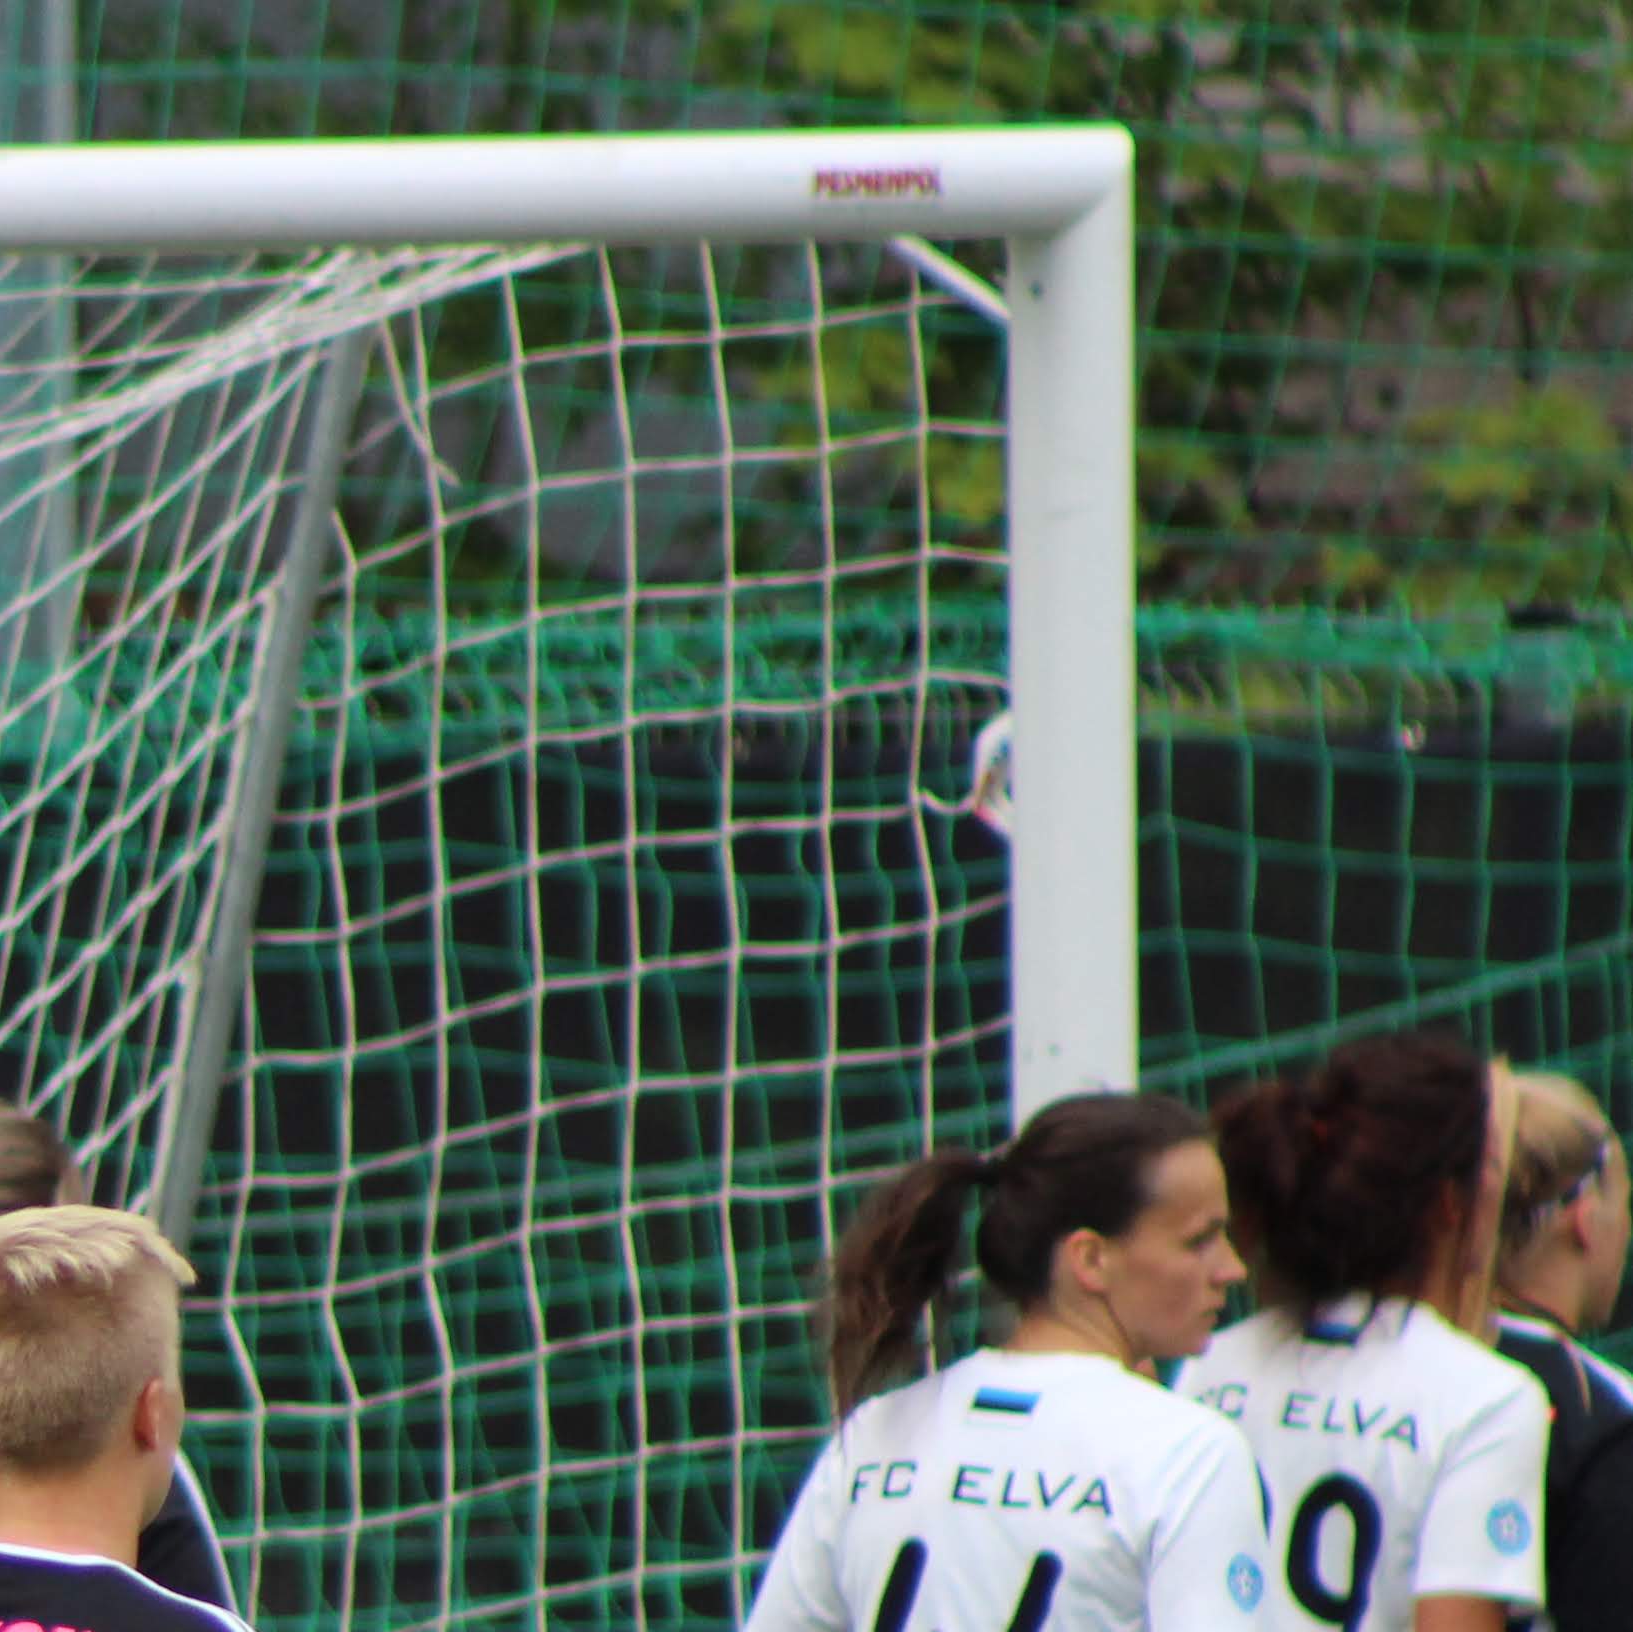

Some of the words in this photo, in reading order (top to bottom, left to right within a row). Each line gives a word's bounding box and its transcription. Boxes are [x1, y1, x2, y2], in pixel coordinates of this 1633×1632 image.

[1280, 1393, 1419, 1452] ELVA
[850, 1461, 917, 1505] FC
[952, 1464, 1113, 1518] ELVA
